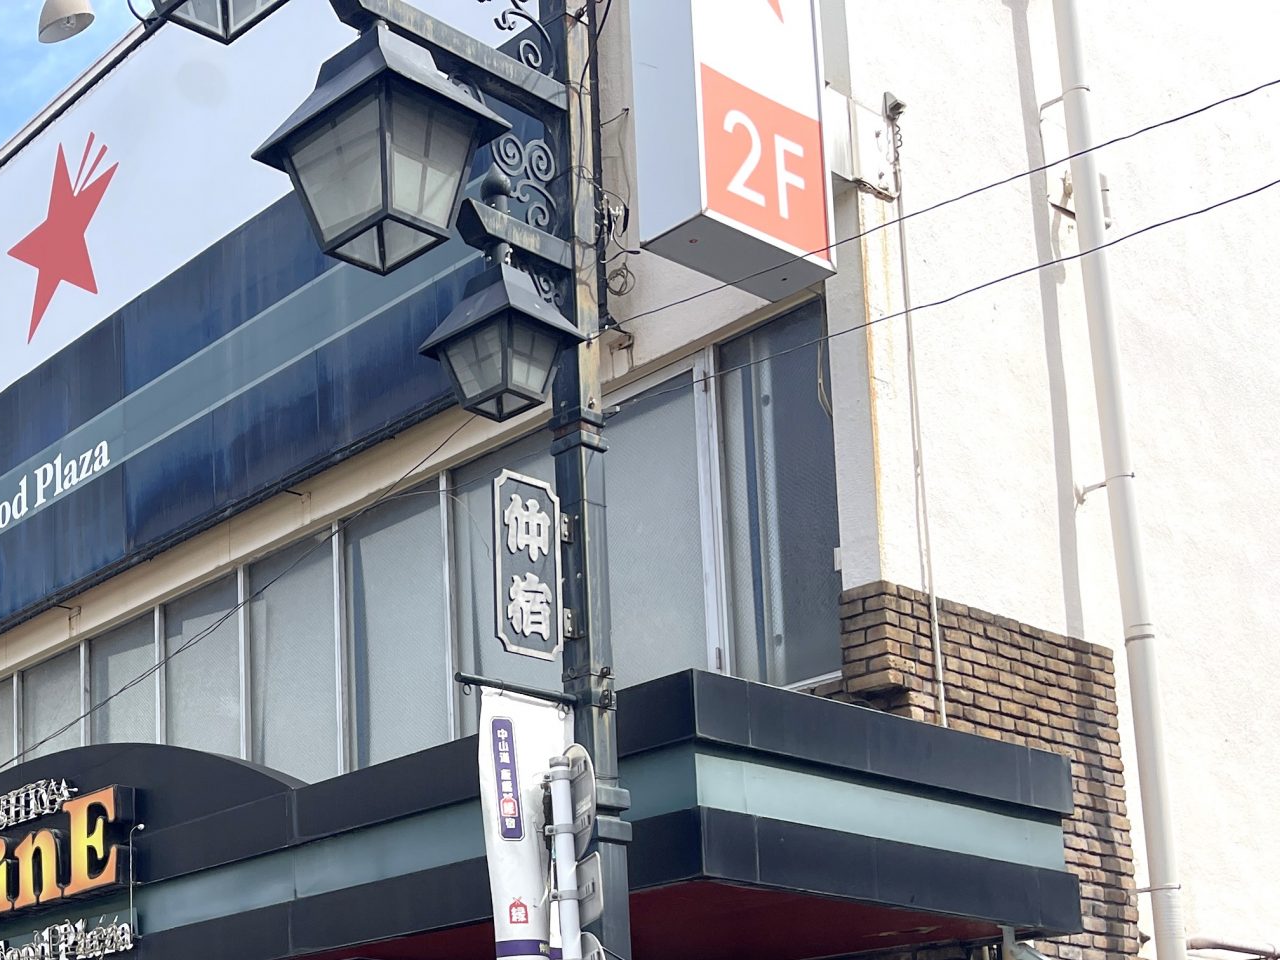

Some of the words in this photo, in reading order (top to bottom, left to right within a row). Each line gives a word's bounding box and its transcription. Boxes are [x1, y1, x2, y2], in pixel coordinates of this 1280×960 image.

[723, 109, 805, 220] 2F
[34, 439, 110, 509] Plaza
[504, 493, 553, 641] 仲宿
